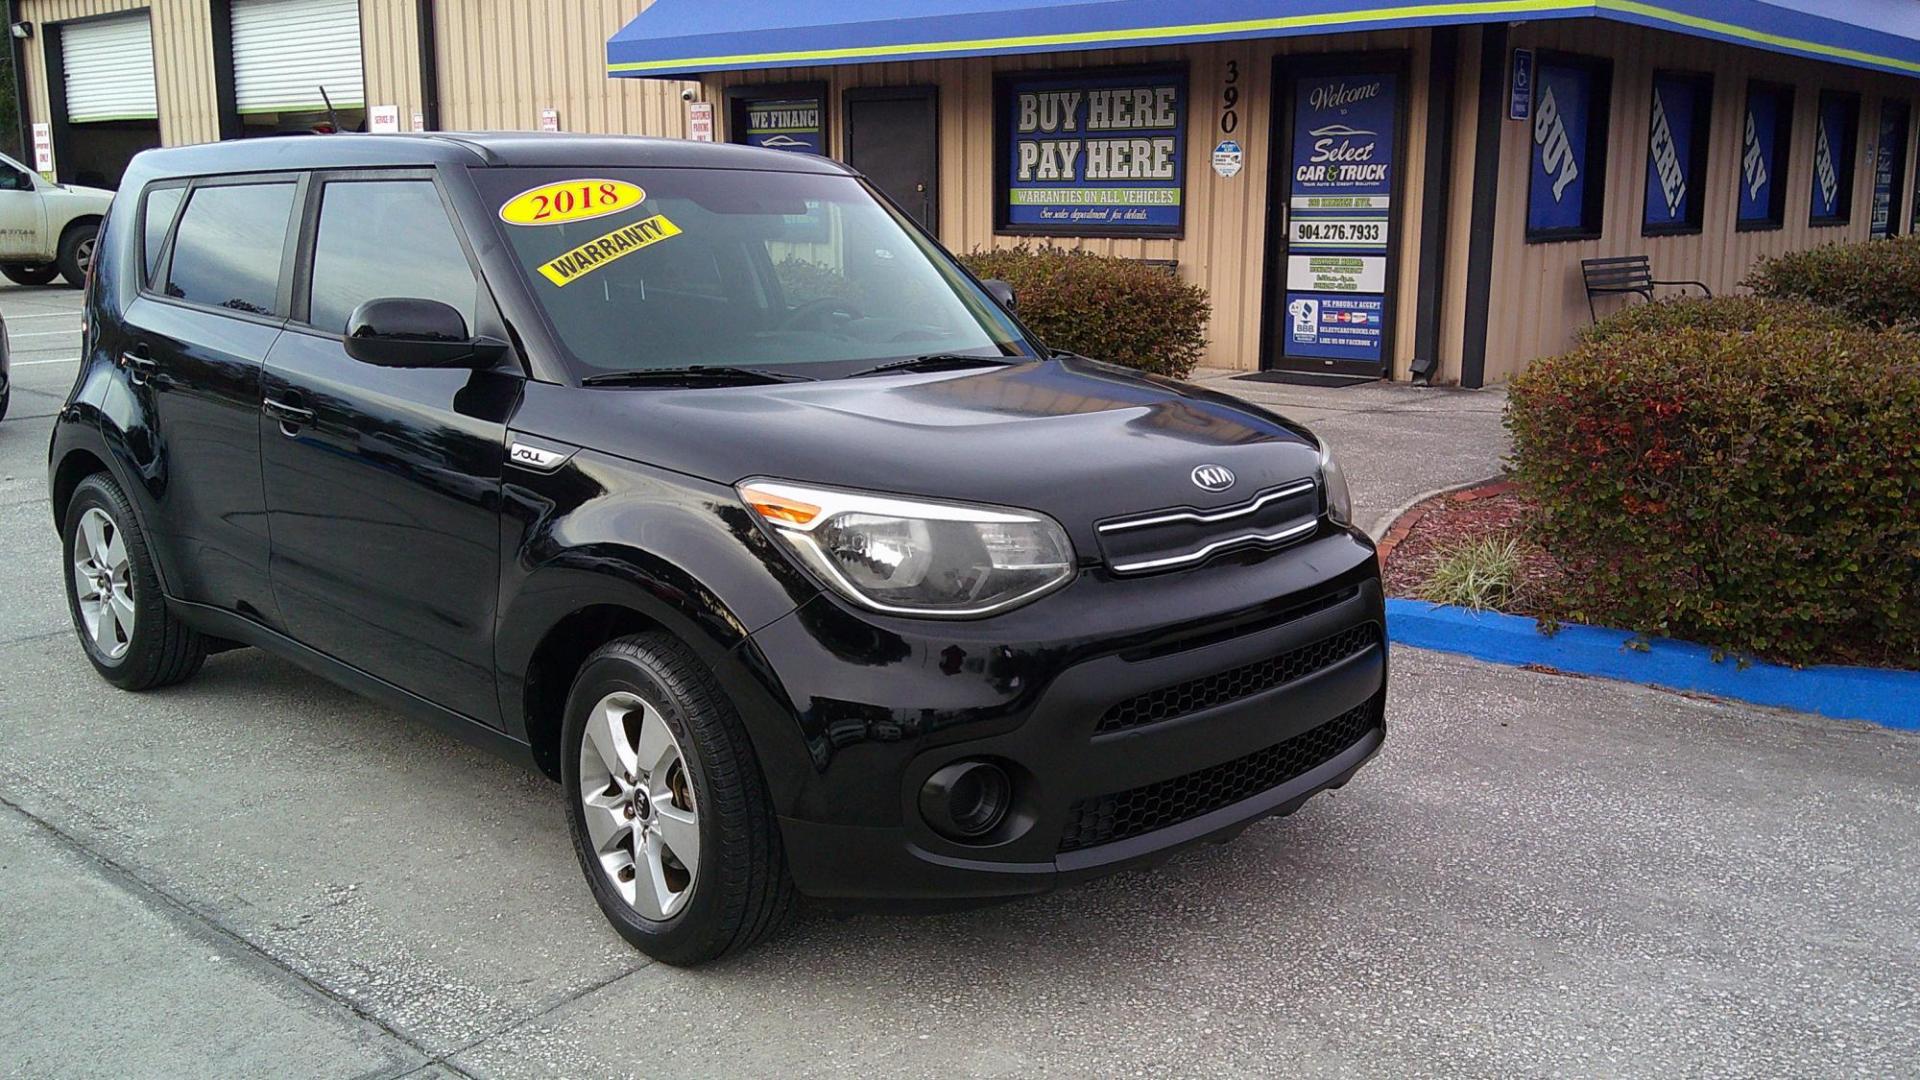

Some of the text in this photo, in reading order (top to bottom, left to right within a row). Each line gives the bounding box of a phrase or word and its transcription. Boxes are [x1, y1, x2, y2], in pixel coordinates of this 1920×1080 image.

[1220, 60, 1239, 134] 390
[1310, 82, 1380, 112] Welcome
[750, 111, 768, 129] WE
[1018, 88, 1176, 132] BUY HERE
[1310, 138, 1375, 162] Select
[1534, 85, 1579, 204] BUY
[1019, 139, 1174, 179] PAY HERE
[1296, 164, 1387, 182] CAR & TRUCK
[530, 183, 618, 220] 2018
[1018, 190, 1174, 203] WARRANTIES ON ALL VEHICLES
[1298, 223, 1380, 241] 904.276.7933
[550, 219, 662, 279] WARRANTY
[1358, 301, 1381, 310] ACCEPT
[1296, 325, 1315, 333] BBB
[1196, 467, 1232, 486] KIA
